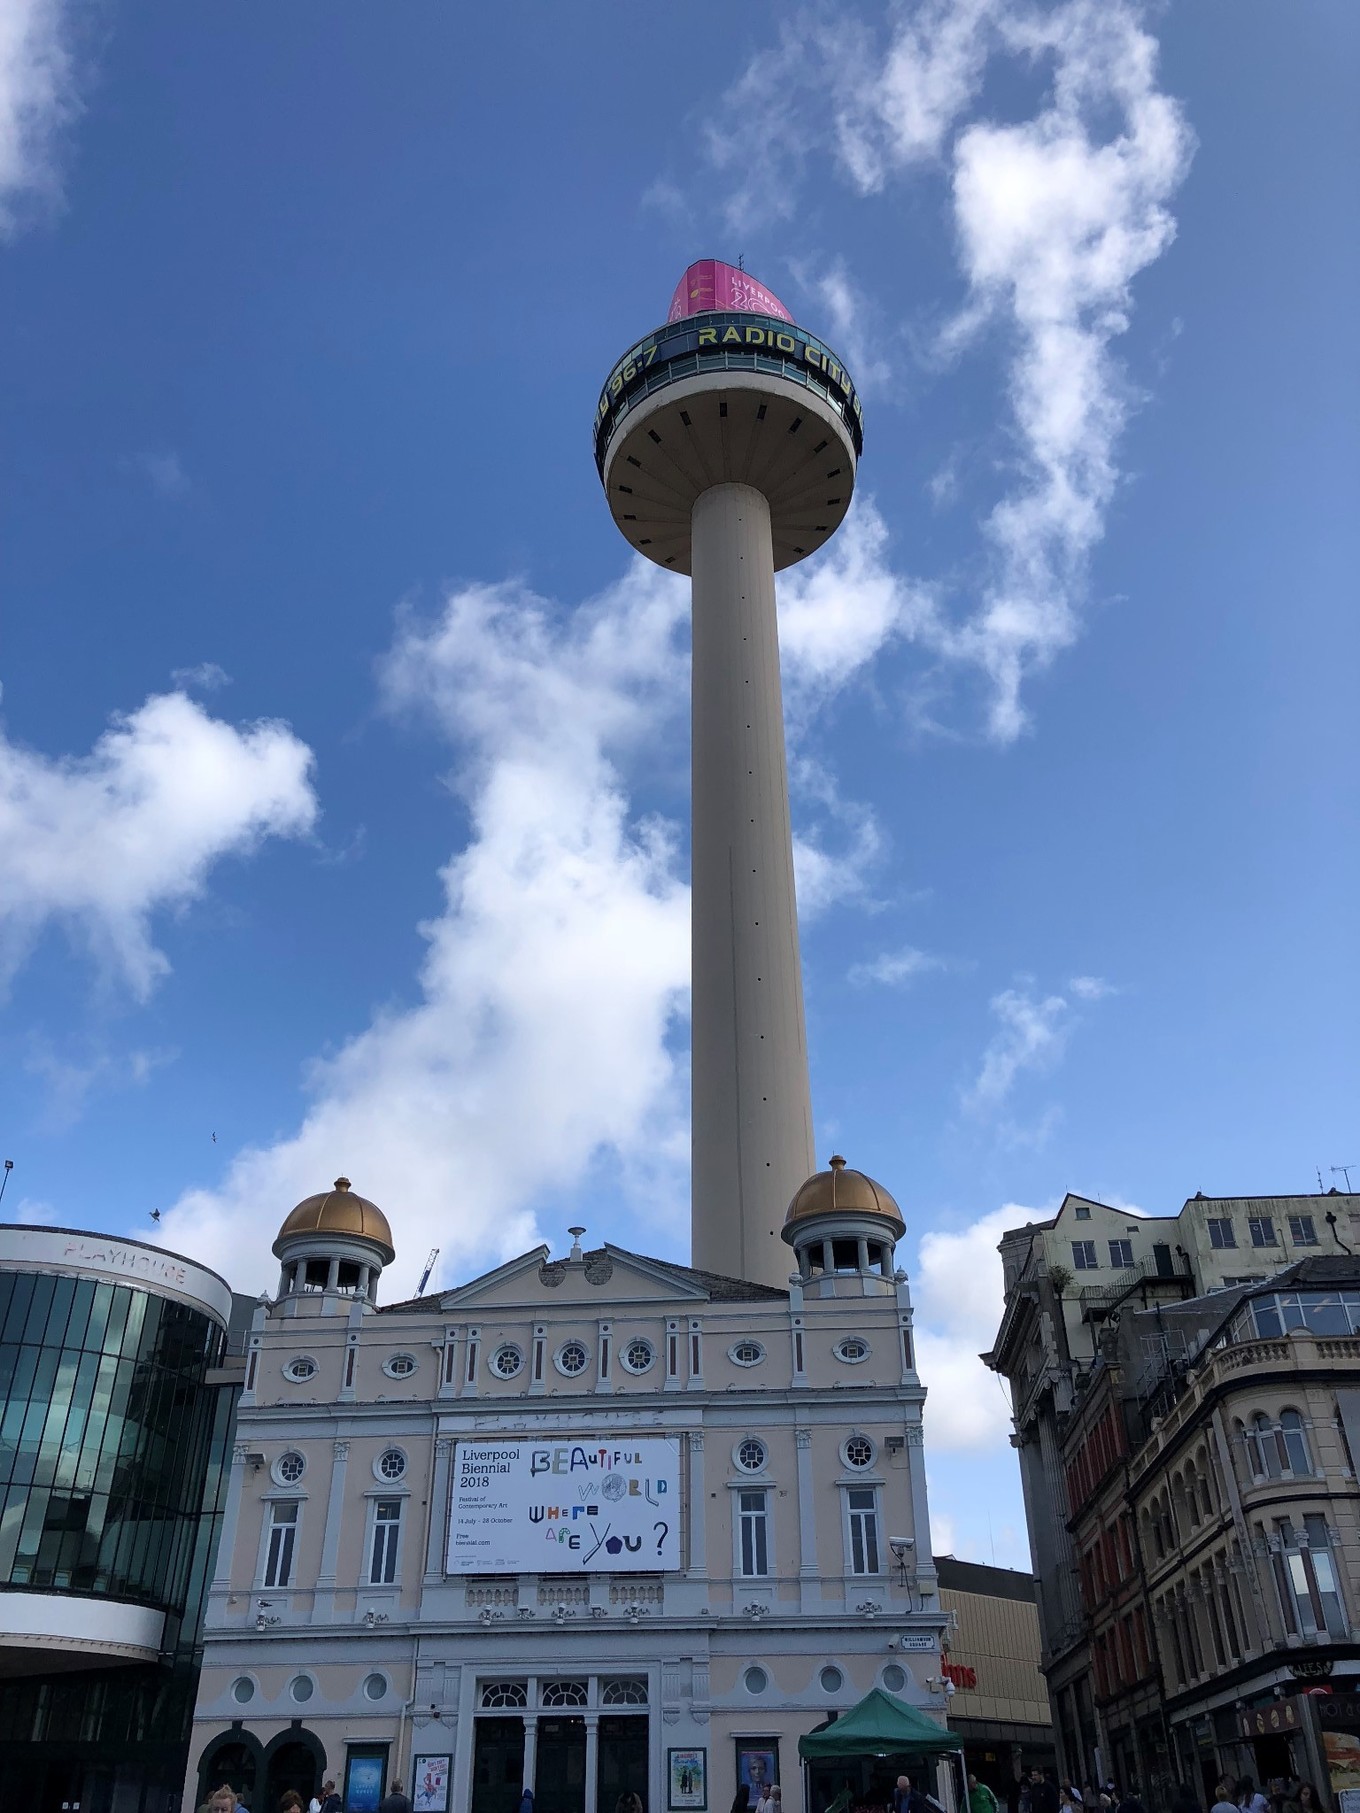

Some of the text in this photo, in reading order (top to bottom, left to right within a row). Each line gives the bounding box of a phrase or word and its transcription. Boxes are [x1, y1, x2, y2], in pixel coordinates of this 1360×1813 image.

[731, 276, 788, 320] LIVERPOO
[698, 326, 796, 354] RADIO
[804, 346, 852, 395] CITY
[64, 1241, 187, 1285] PLAYHOUSE
[462, 1448, 520, 1462] Liverpool
[461, 1462, 511, 1475] Biennial
[460, 1476, 490, 1488] 2018
[464, 1518, 476, 1526] July
